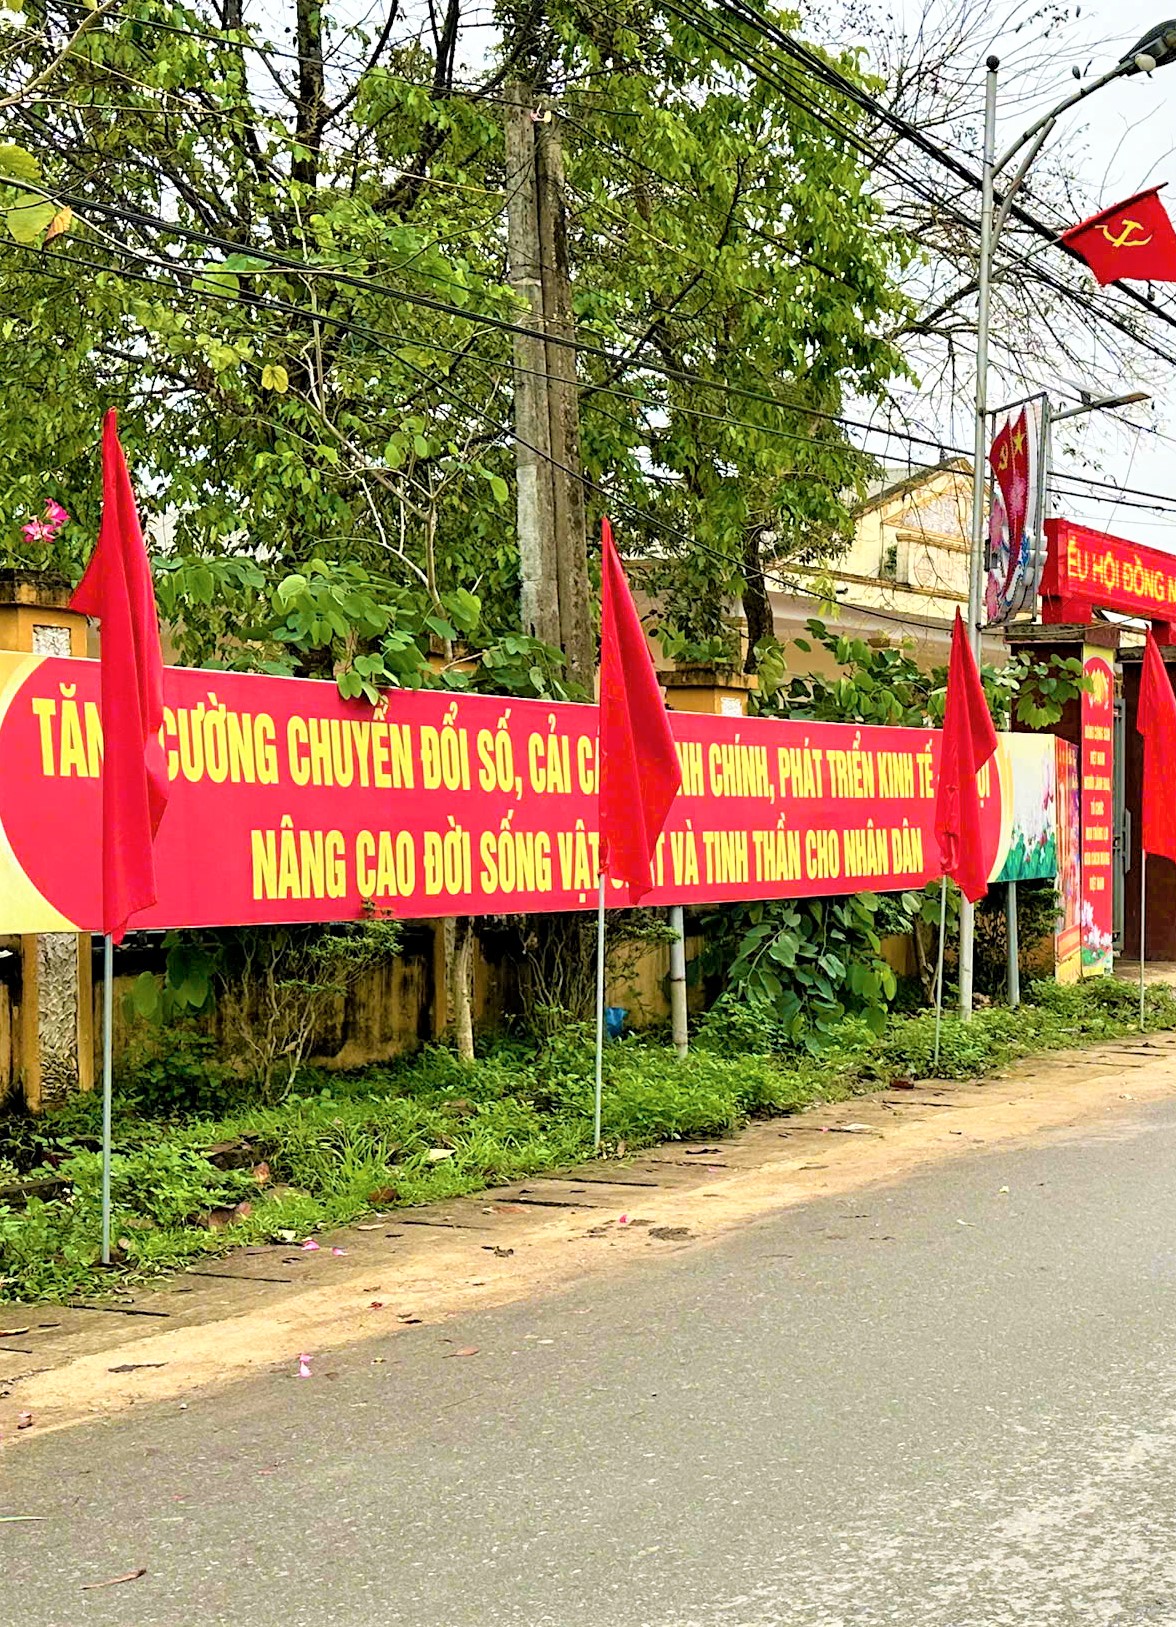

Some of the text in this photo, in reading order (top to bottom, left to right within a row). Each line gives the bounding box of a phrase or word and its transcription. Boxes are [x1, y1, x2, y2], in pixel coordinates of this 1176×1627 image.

[1092, 551, 1120, 595] HỘI
[1122, 555, 1165, 602] ĐỒNG
[32, 683, 104, 777] TĂN
[158, 692, 279, 784] CƯỜNG
[287, 695, 414, 788] CHUYỂN
[420, 702, 471, 790] ĐỔI
[477, 709, 522, 800] SỐ,
[529, 714, 571, 793] CẢI
[674, 742, 704, 796] NH
[709, 734, 775, 804] CHÍNH,
[778, 738, 822, 798] PHÁT
[826, 731, 874, 798] TRIỂN
[877, 752, 914, 798] KINH
[916, 739, 934, 798] TẾ
[251, 815, 346, 899] NÂNG
[356, 830, 415, 897] CAO
[424, 816, 471, 894] ĐỜI
[480, 810, 552, 894] SỐNG
[558, 819, 599, 902] VẬT
[670, 819, 699, 885] VÀ
[703, 831, 748, 884] TINH
[752, 813, 801, 881] THẦN
[806, 830, 839, 879] CHO
[844, 819, 888, 877] NHÂN
[891, 818, 923, 874] DÂN
